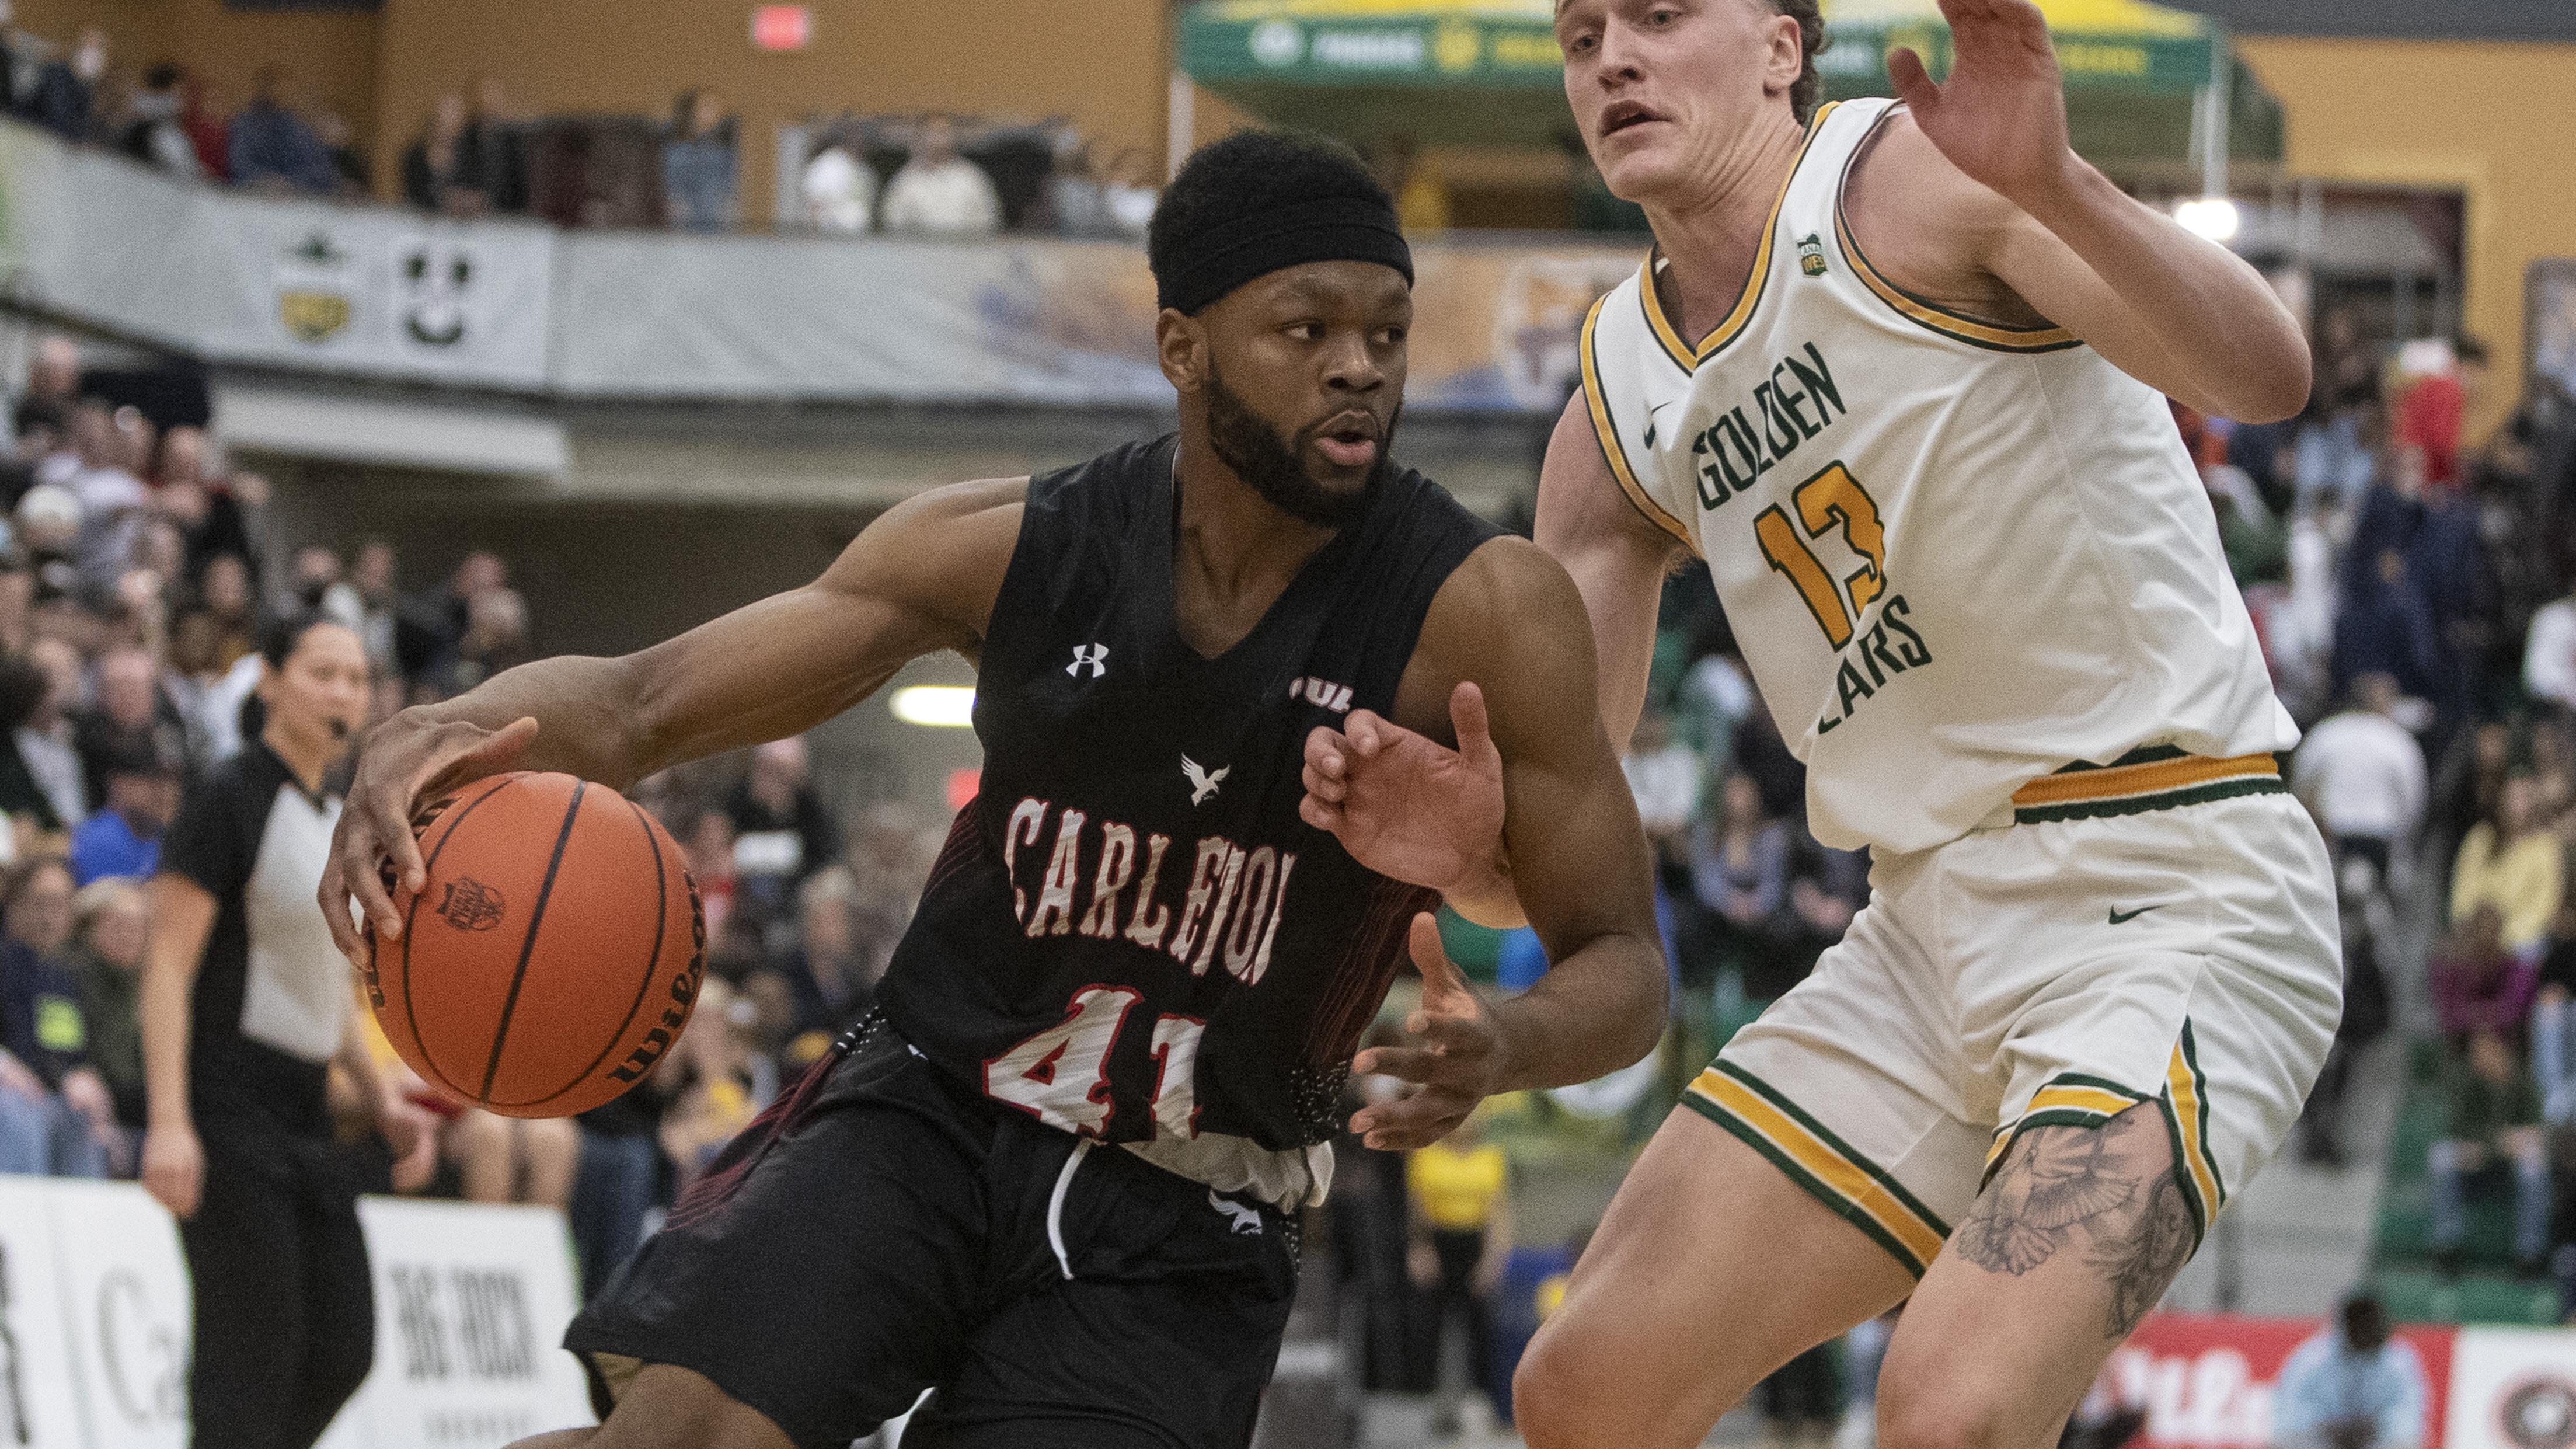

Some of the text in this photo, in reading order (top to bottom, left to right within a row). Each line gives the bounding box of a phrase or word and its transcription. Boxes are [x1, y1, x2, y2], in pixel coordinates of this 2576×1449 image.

[1692, 340, 1846, 511] GOLDEN
[1754, 459, 1887, 652] 13
[982, 983, 1207, 1145] 41
